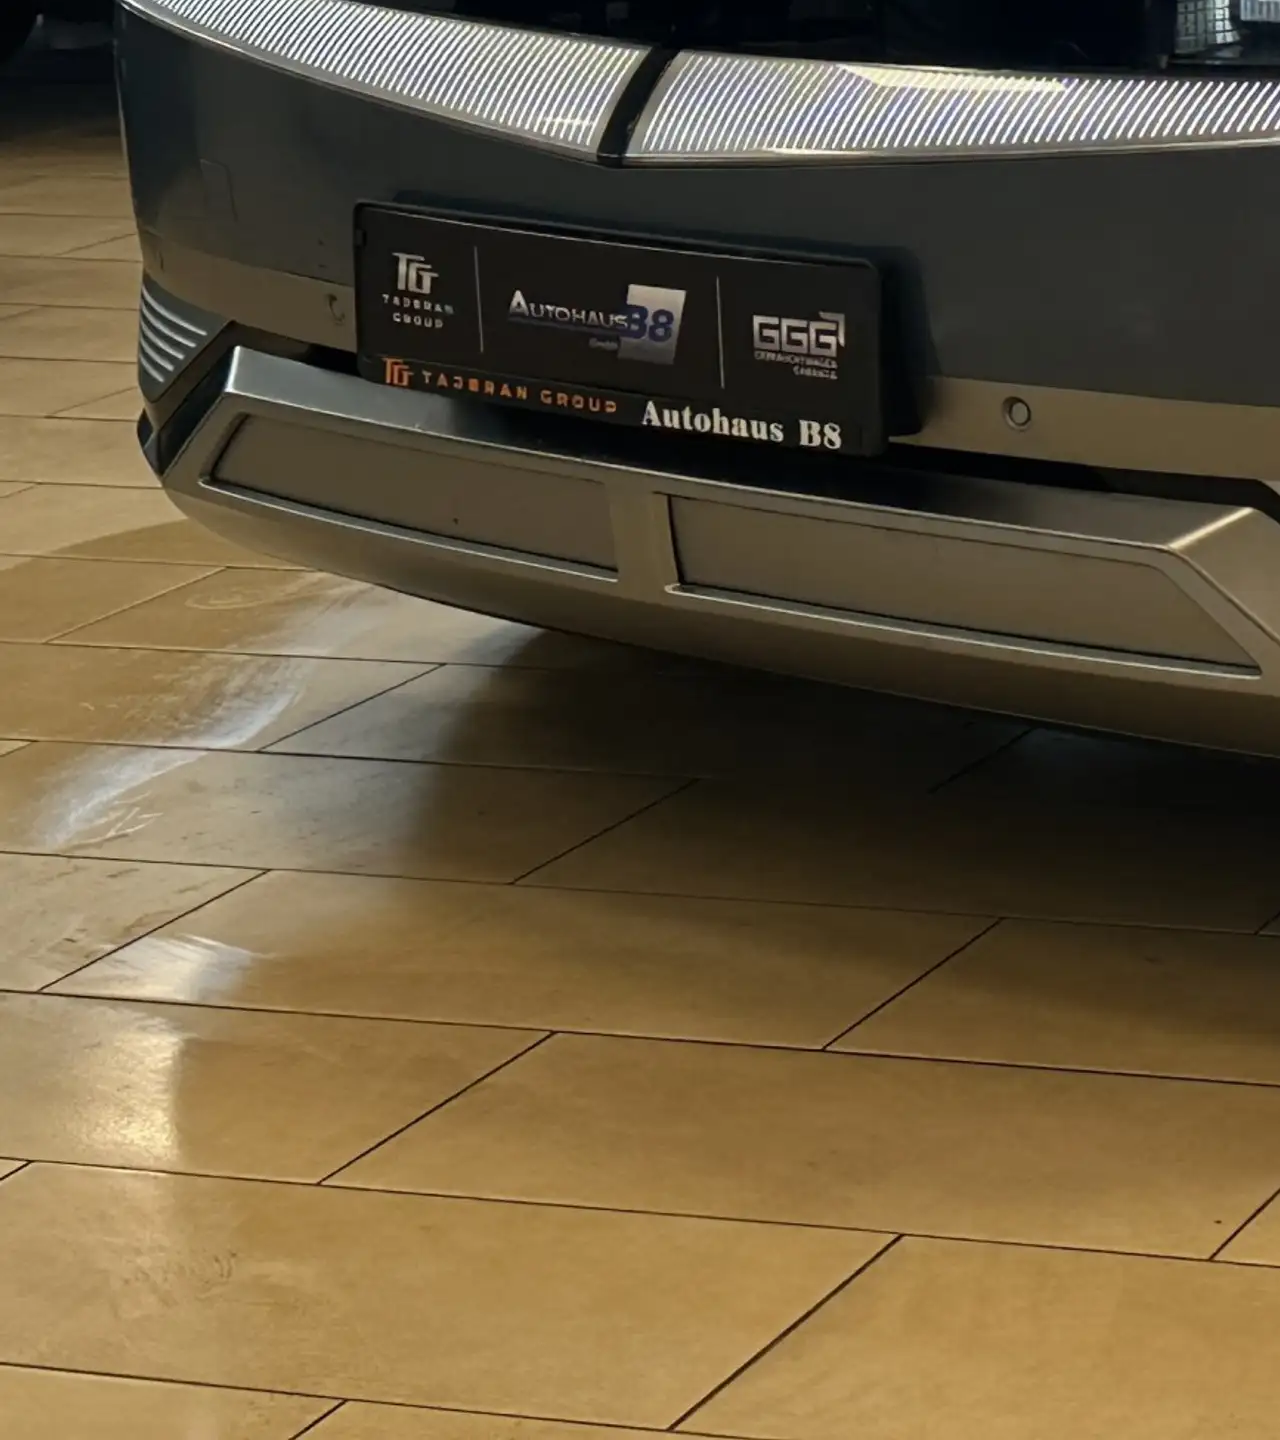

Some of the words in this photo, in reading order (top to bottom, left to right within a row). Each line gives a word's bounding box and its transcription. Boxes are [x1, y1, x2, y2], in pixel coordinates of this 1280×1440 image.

[539, 388, 618, 413] GROUP
[641, 399, 785, 443] Autohaus
[798, 418, 843, 450] B8
